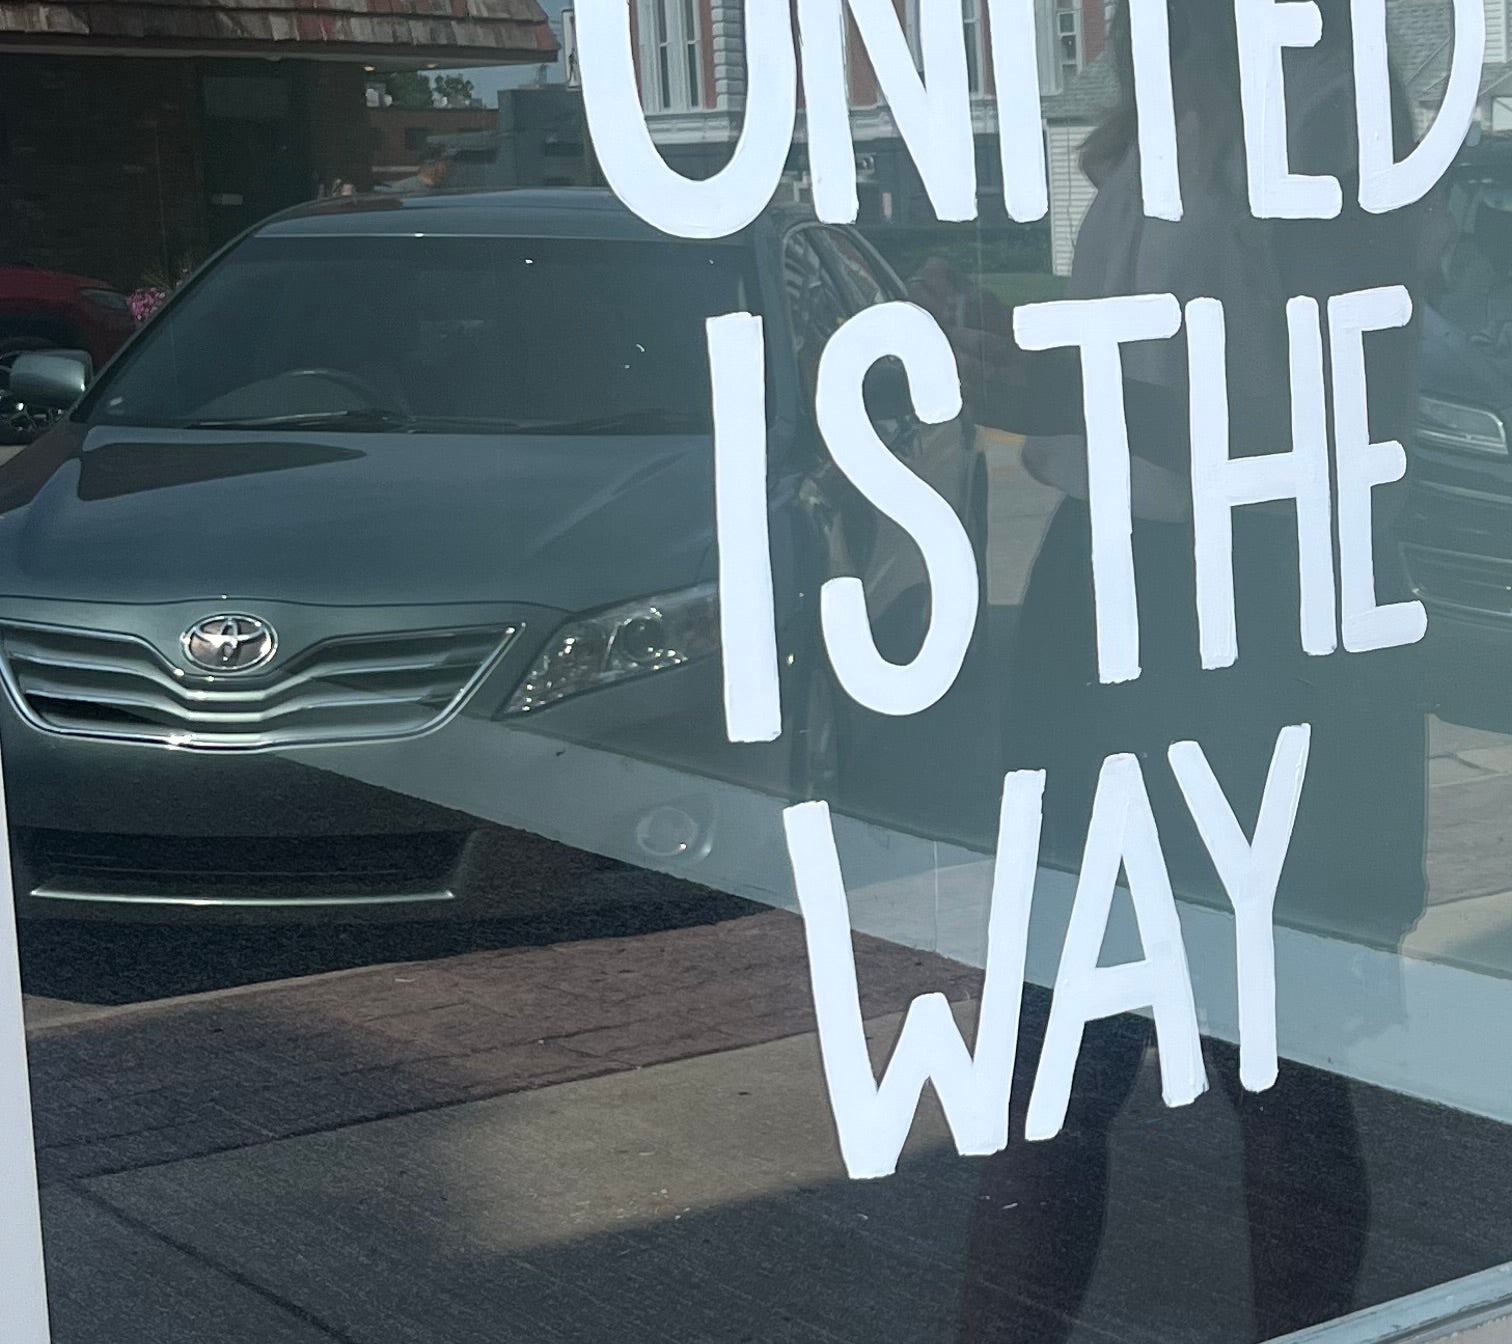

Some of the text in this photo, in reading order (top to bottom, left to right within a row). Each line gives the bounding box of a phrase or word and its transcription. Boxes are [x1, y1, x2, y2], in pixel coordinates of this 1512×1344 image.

[705, 285, 1428, 743] IS THE
[782, 723, 1311, 1180] WAY
